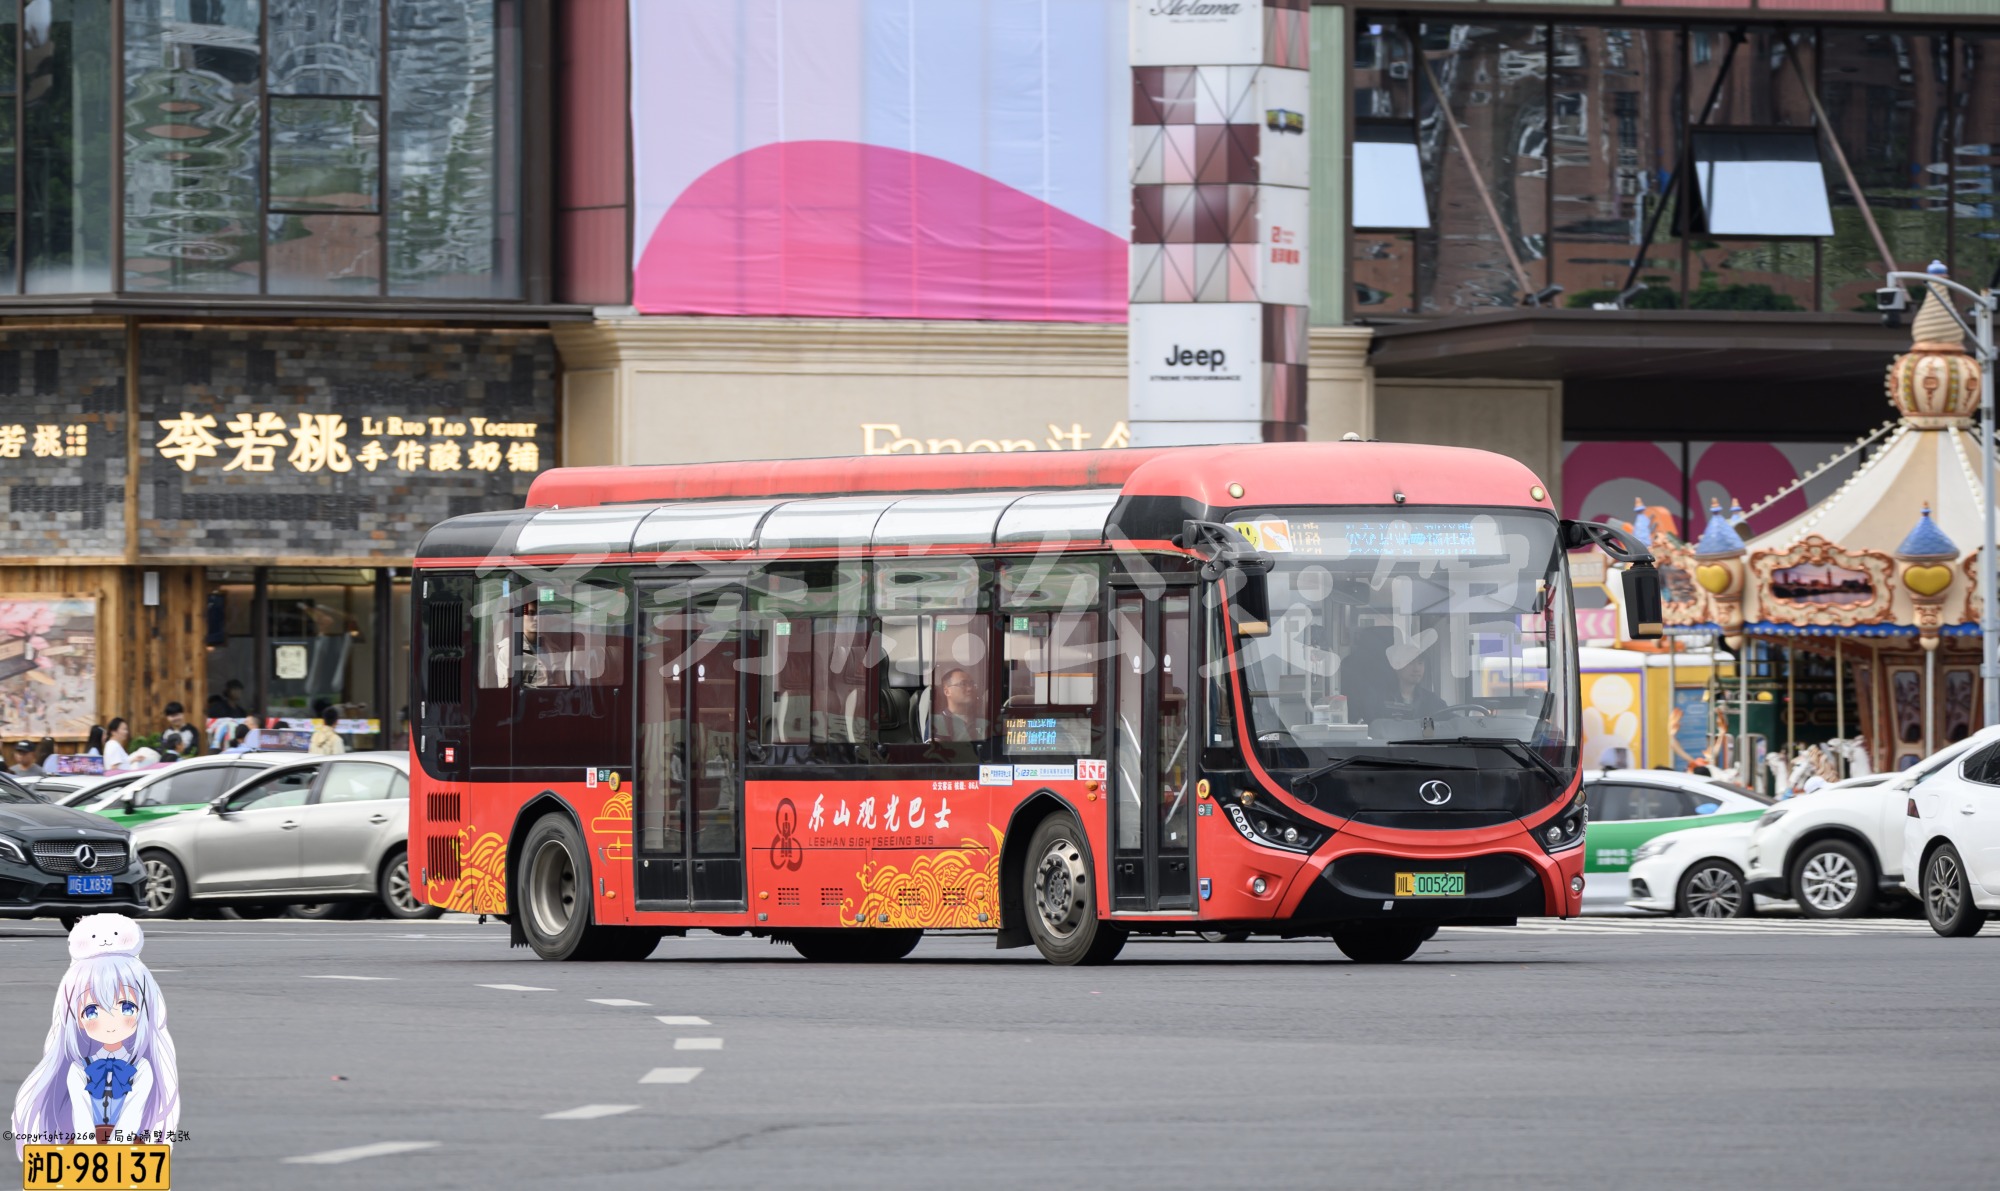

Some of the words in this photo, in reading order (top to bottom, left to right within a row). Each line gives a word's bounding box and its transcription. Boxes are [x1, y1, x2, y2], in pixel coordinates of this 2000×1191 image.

[1165, 344, 1225, 372] Jeep
[155, 411, 352, 472] 李若桃
[356, 439, 540, 472] 手作酸奶铺
[808, 793, 952, 832] 乐山观光巴士
[809, 837, 846, 847] LESHAN
[849, 836, 912, 847] SIGHTSEEING
[915, 835, 934, 845] BUS
